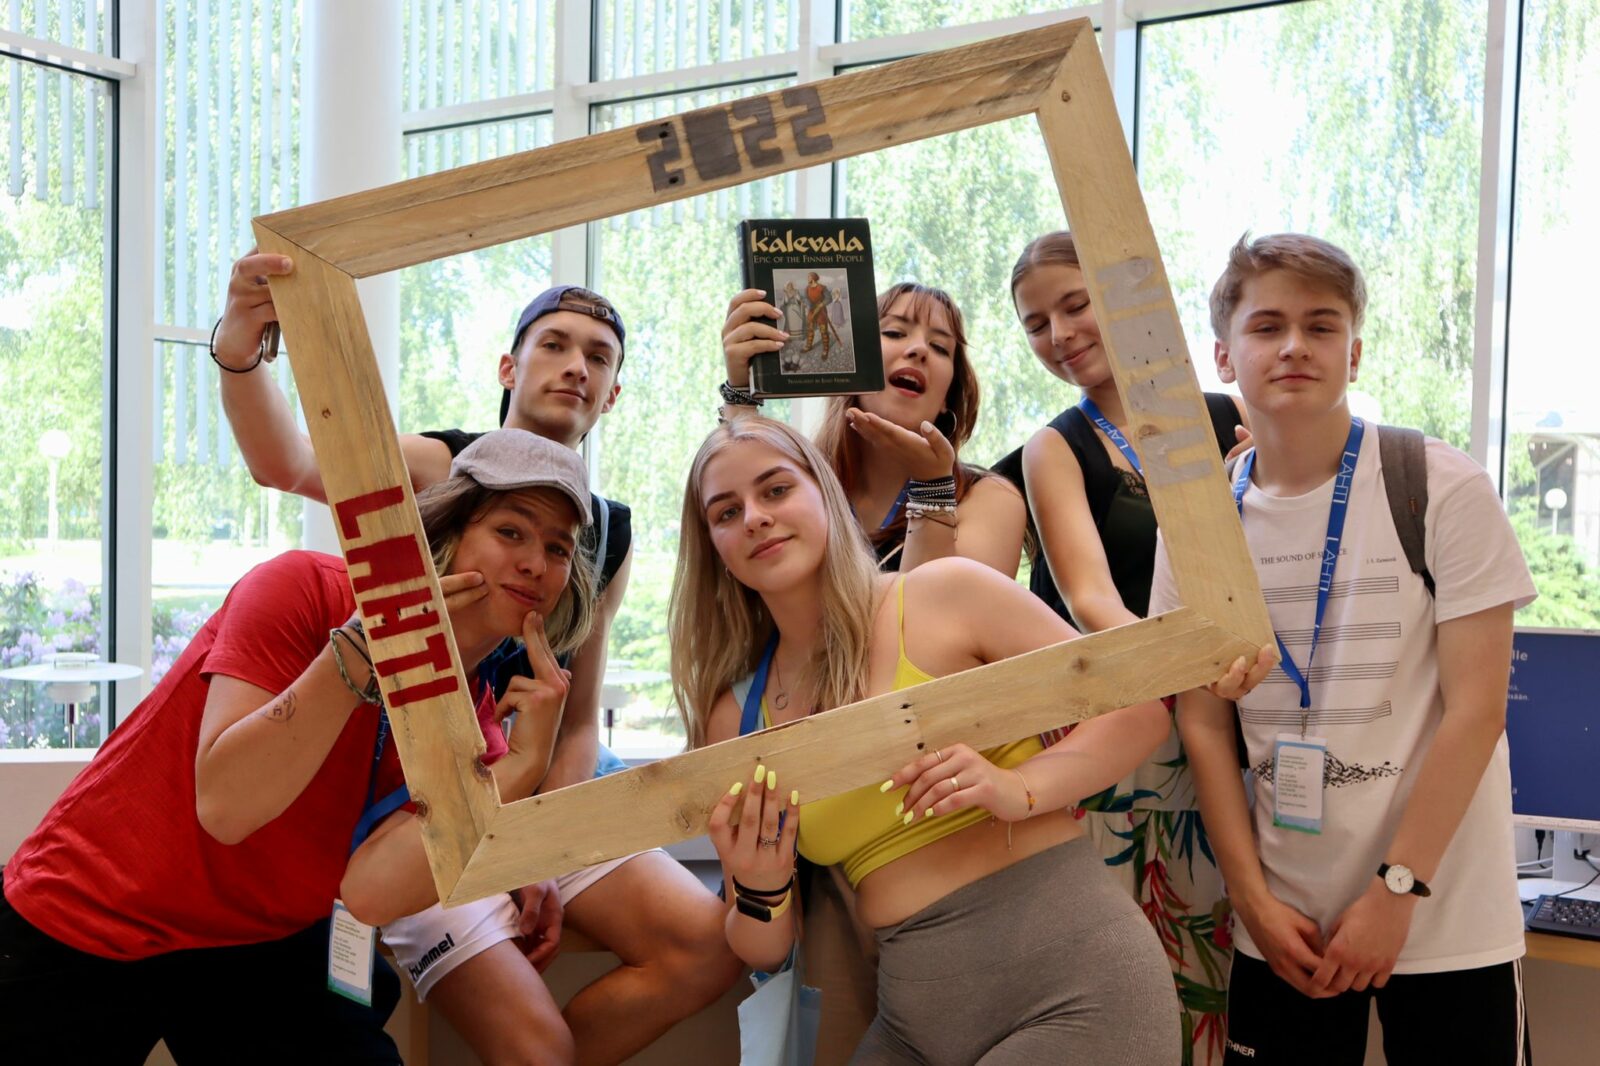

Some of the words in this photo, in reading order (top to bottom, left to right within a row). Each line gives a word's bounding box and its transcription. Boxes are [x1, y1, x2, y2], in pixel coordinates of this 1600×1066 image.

[636, 86, 833, 193] 2022
[763, 228, 776, 236] THE
[753, 255, 770, 264] EPIC
[773, 255, 784, 263] OF
[786, 255, 800, 263] THE
[802, 254, 834, 263] FINNISH
[836, 254, 865, 262] PEOPLE
[1094, 417, 1129, 450] LAHTI
[1333, 451, 1357, 504] LAHTI
[1260, 557, 1274, 565] THE
[1276, 553, 1303, 563] SOUND
[1304, 551, 1316, 560] OF
[335, 485, 459, 708] LAHTI
[408, 933, 455, 981] hummel
